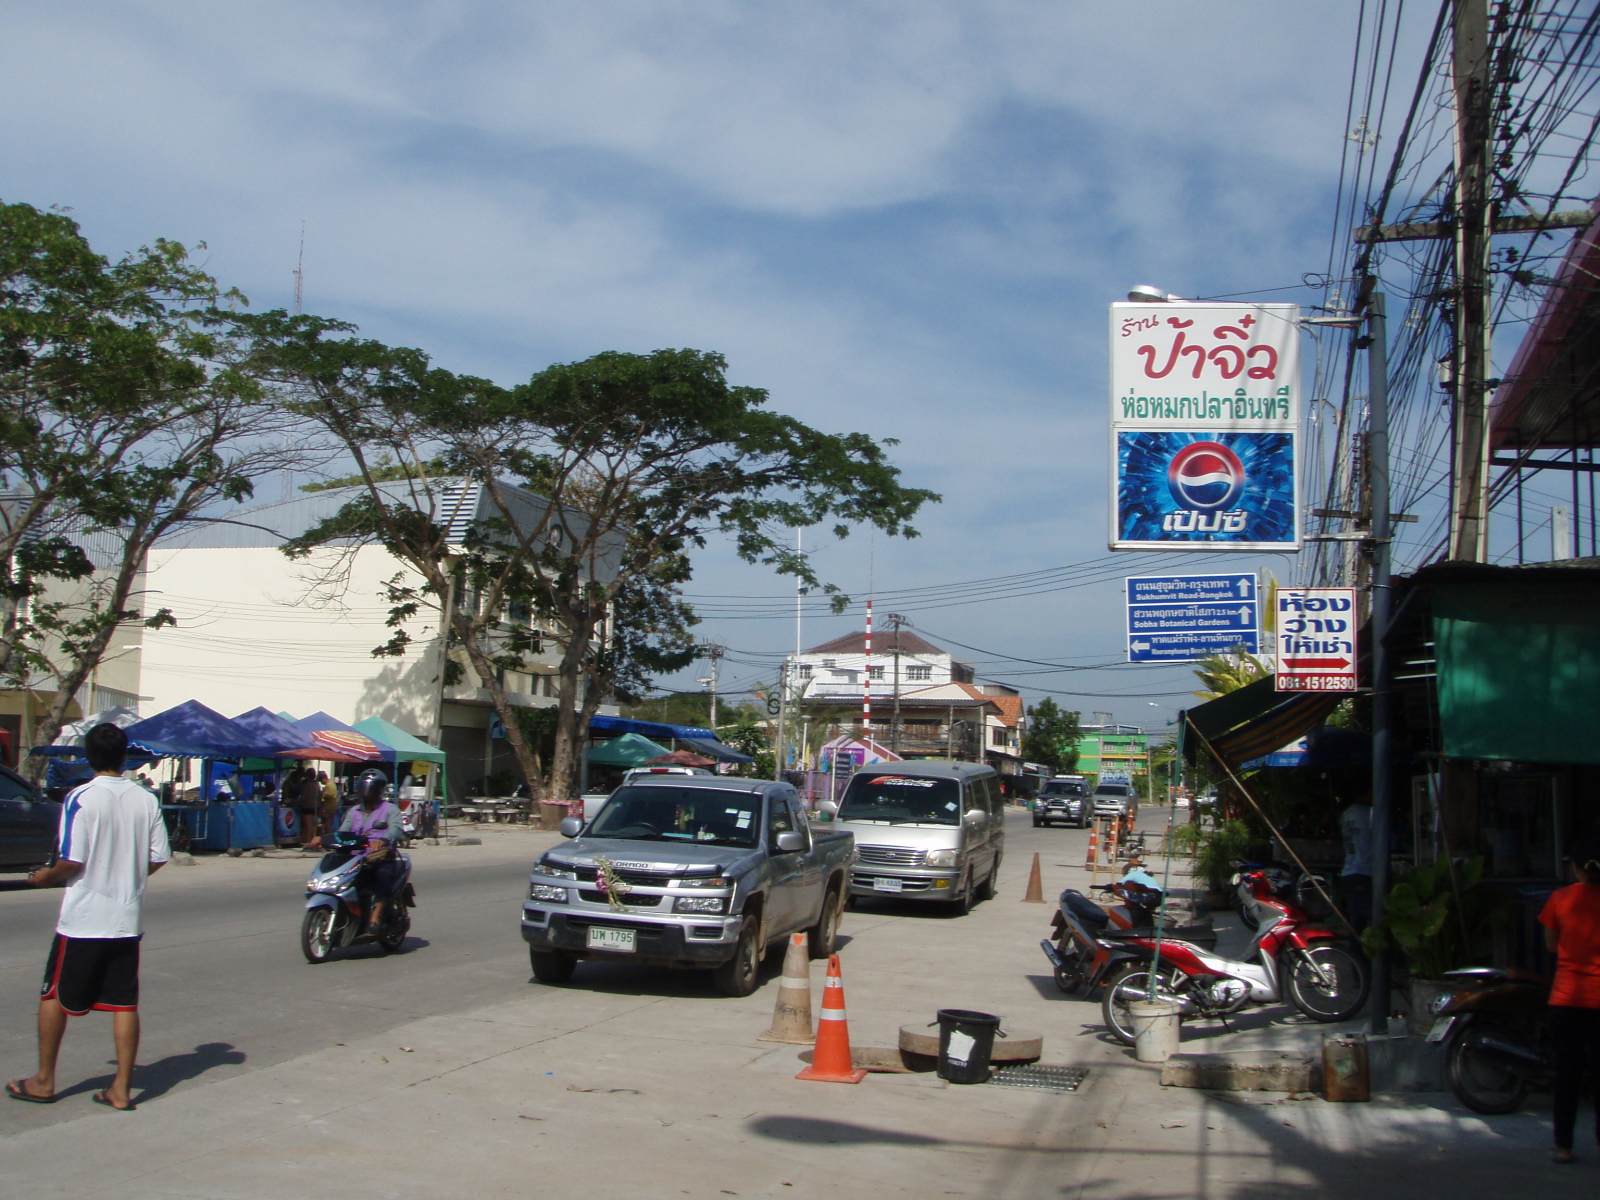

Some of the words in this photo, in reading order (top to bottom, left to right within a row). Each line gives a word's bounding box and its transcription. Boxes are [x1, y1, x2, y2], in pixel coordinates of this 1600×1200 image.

[1121, 313, 1160, 338] ร้าน
[1137, 313, 1278, 380] ป้าจิ๋ว
[1121, 385, 1290, 420] ห่อหมกปลาอินทรี
[1135, 593, 1177, 601] Sukhumvit
[1178, 591, 1234, 600] Road-Bangkok
[1279, 592, 1352, 612] ห้อง
[1133, 620, 1158, 628] Sobha
[1159, 618, 1197, 628] Botanical
[1197, 618, 1231, 627] Gardens
[1284, 614, 1347, 633] ว่าง
[1279, 634, 1353, 654] ให้เช่า
[610, 931, 633, 943] 1795
